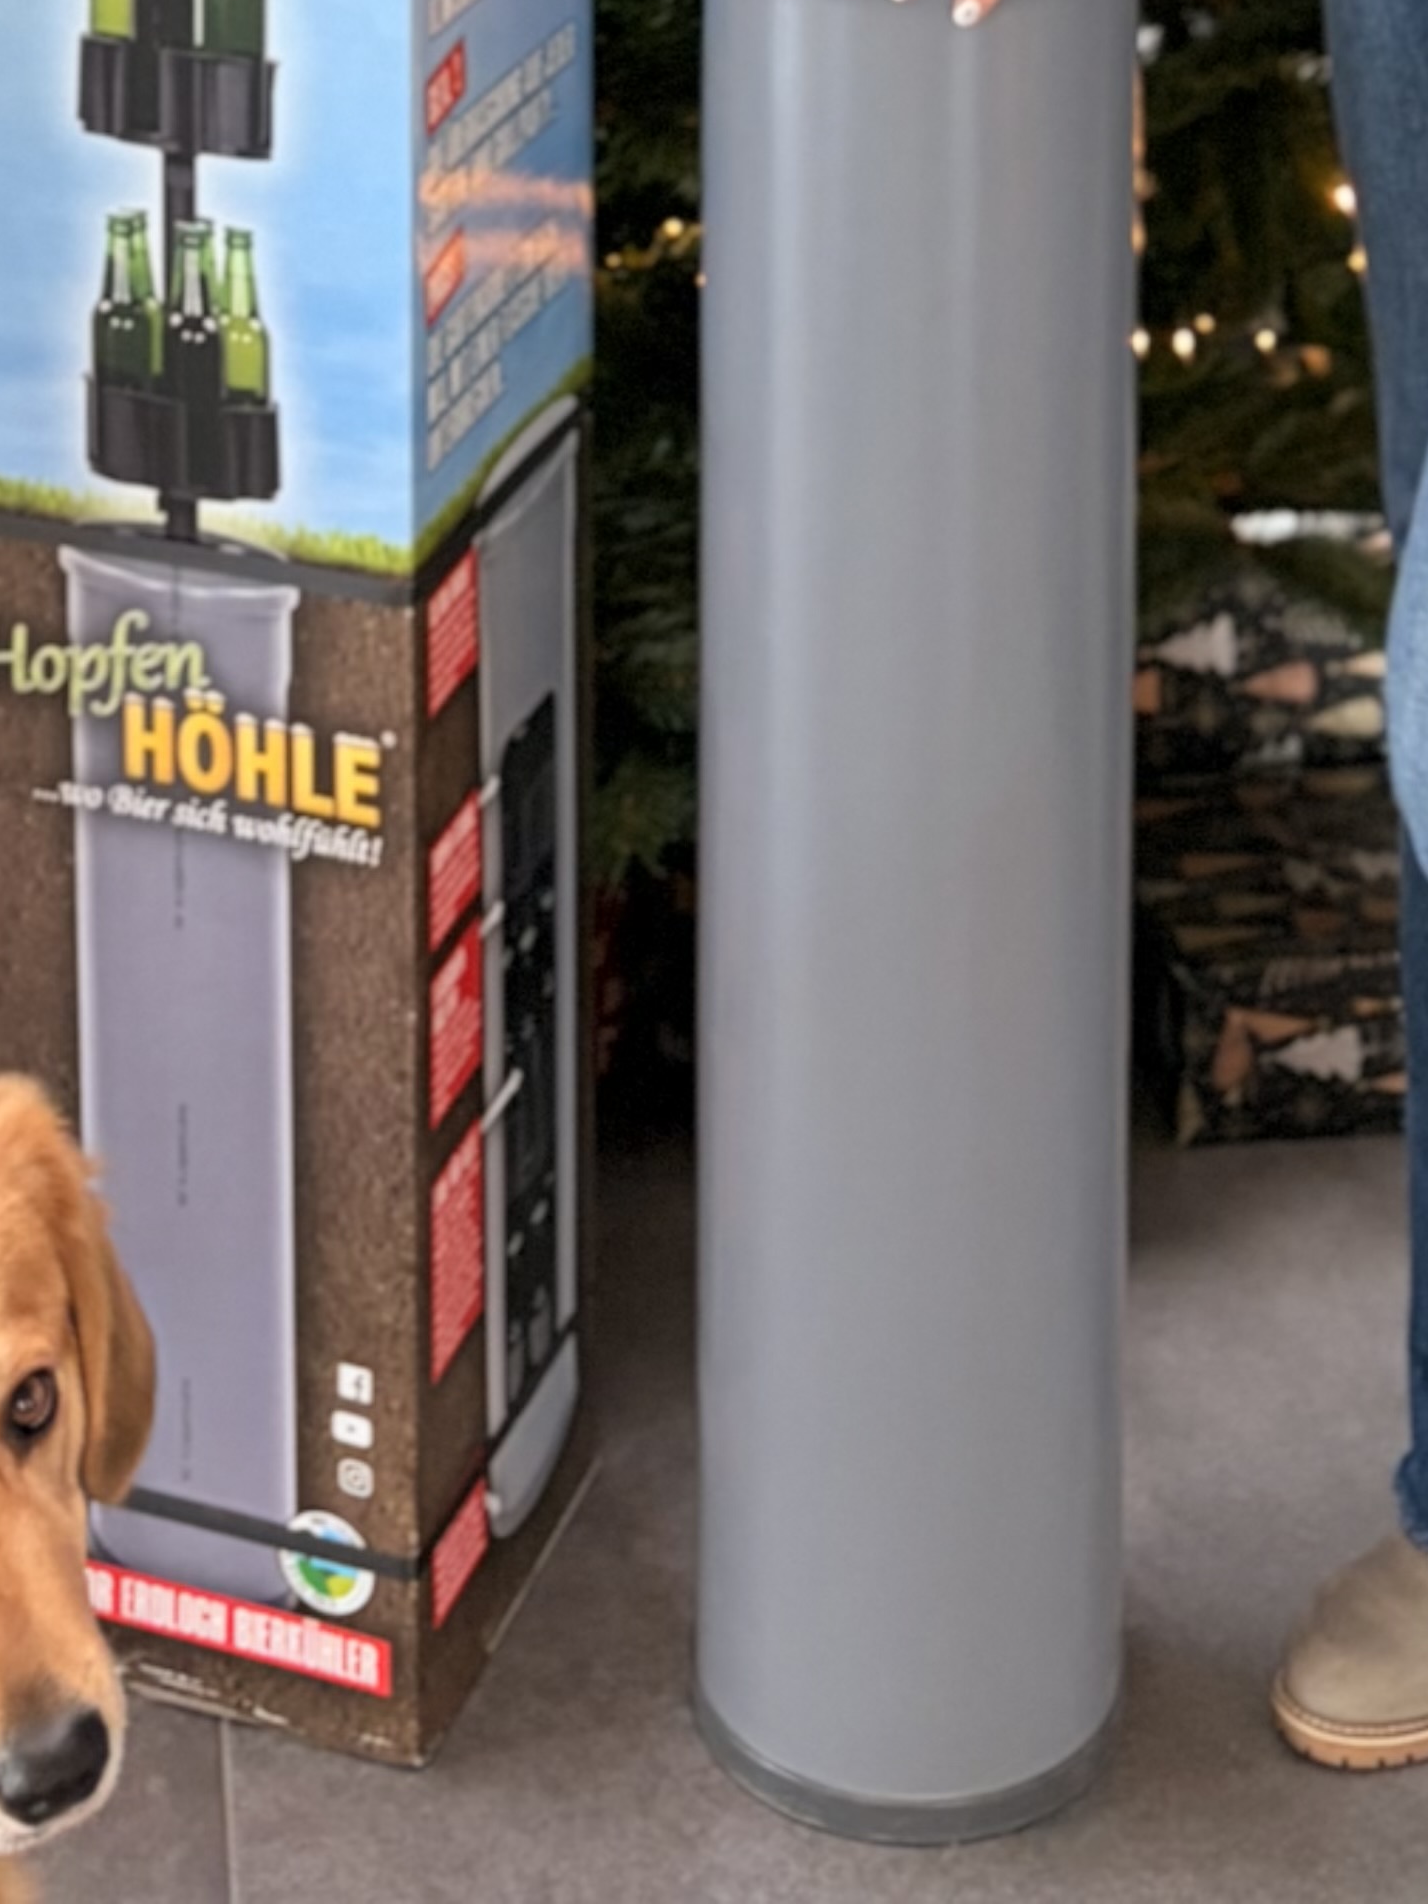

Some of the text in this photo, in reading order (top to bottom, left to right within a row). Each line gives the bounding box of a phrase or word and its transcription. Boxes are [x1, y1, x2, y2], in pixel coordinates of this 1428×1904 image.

[107, 783, 171, 824] Bier
[171, 799, 227, 836] sich
[231, 812, 384, 869] wohlfühlt!
[232, 1605, 380, 1689] BIERKÜHLER
